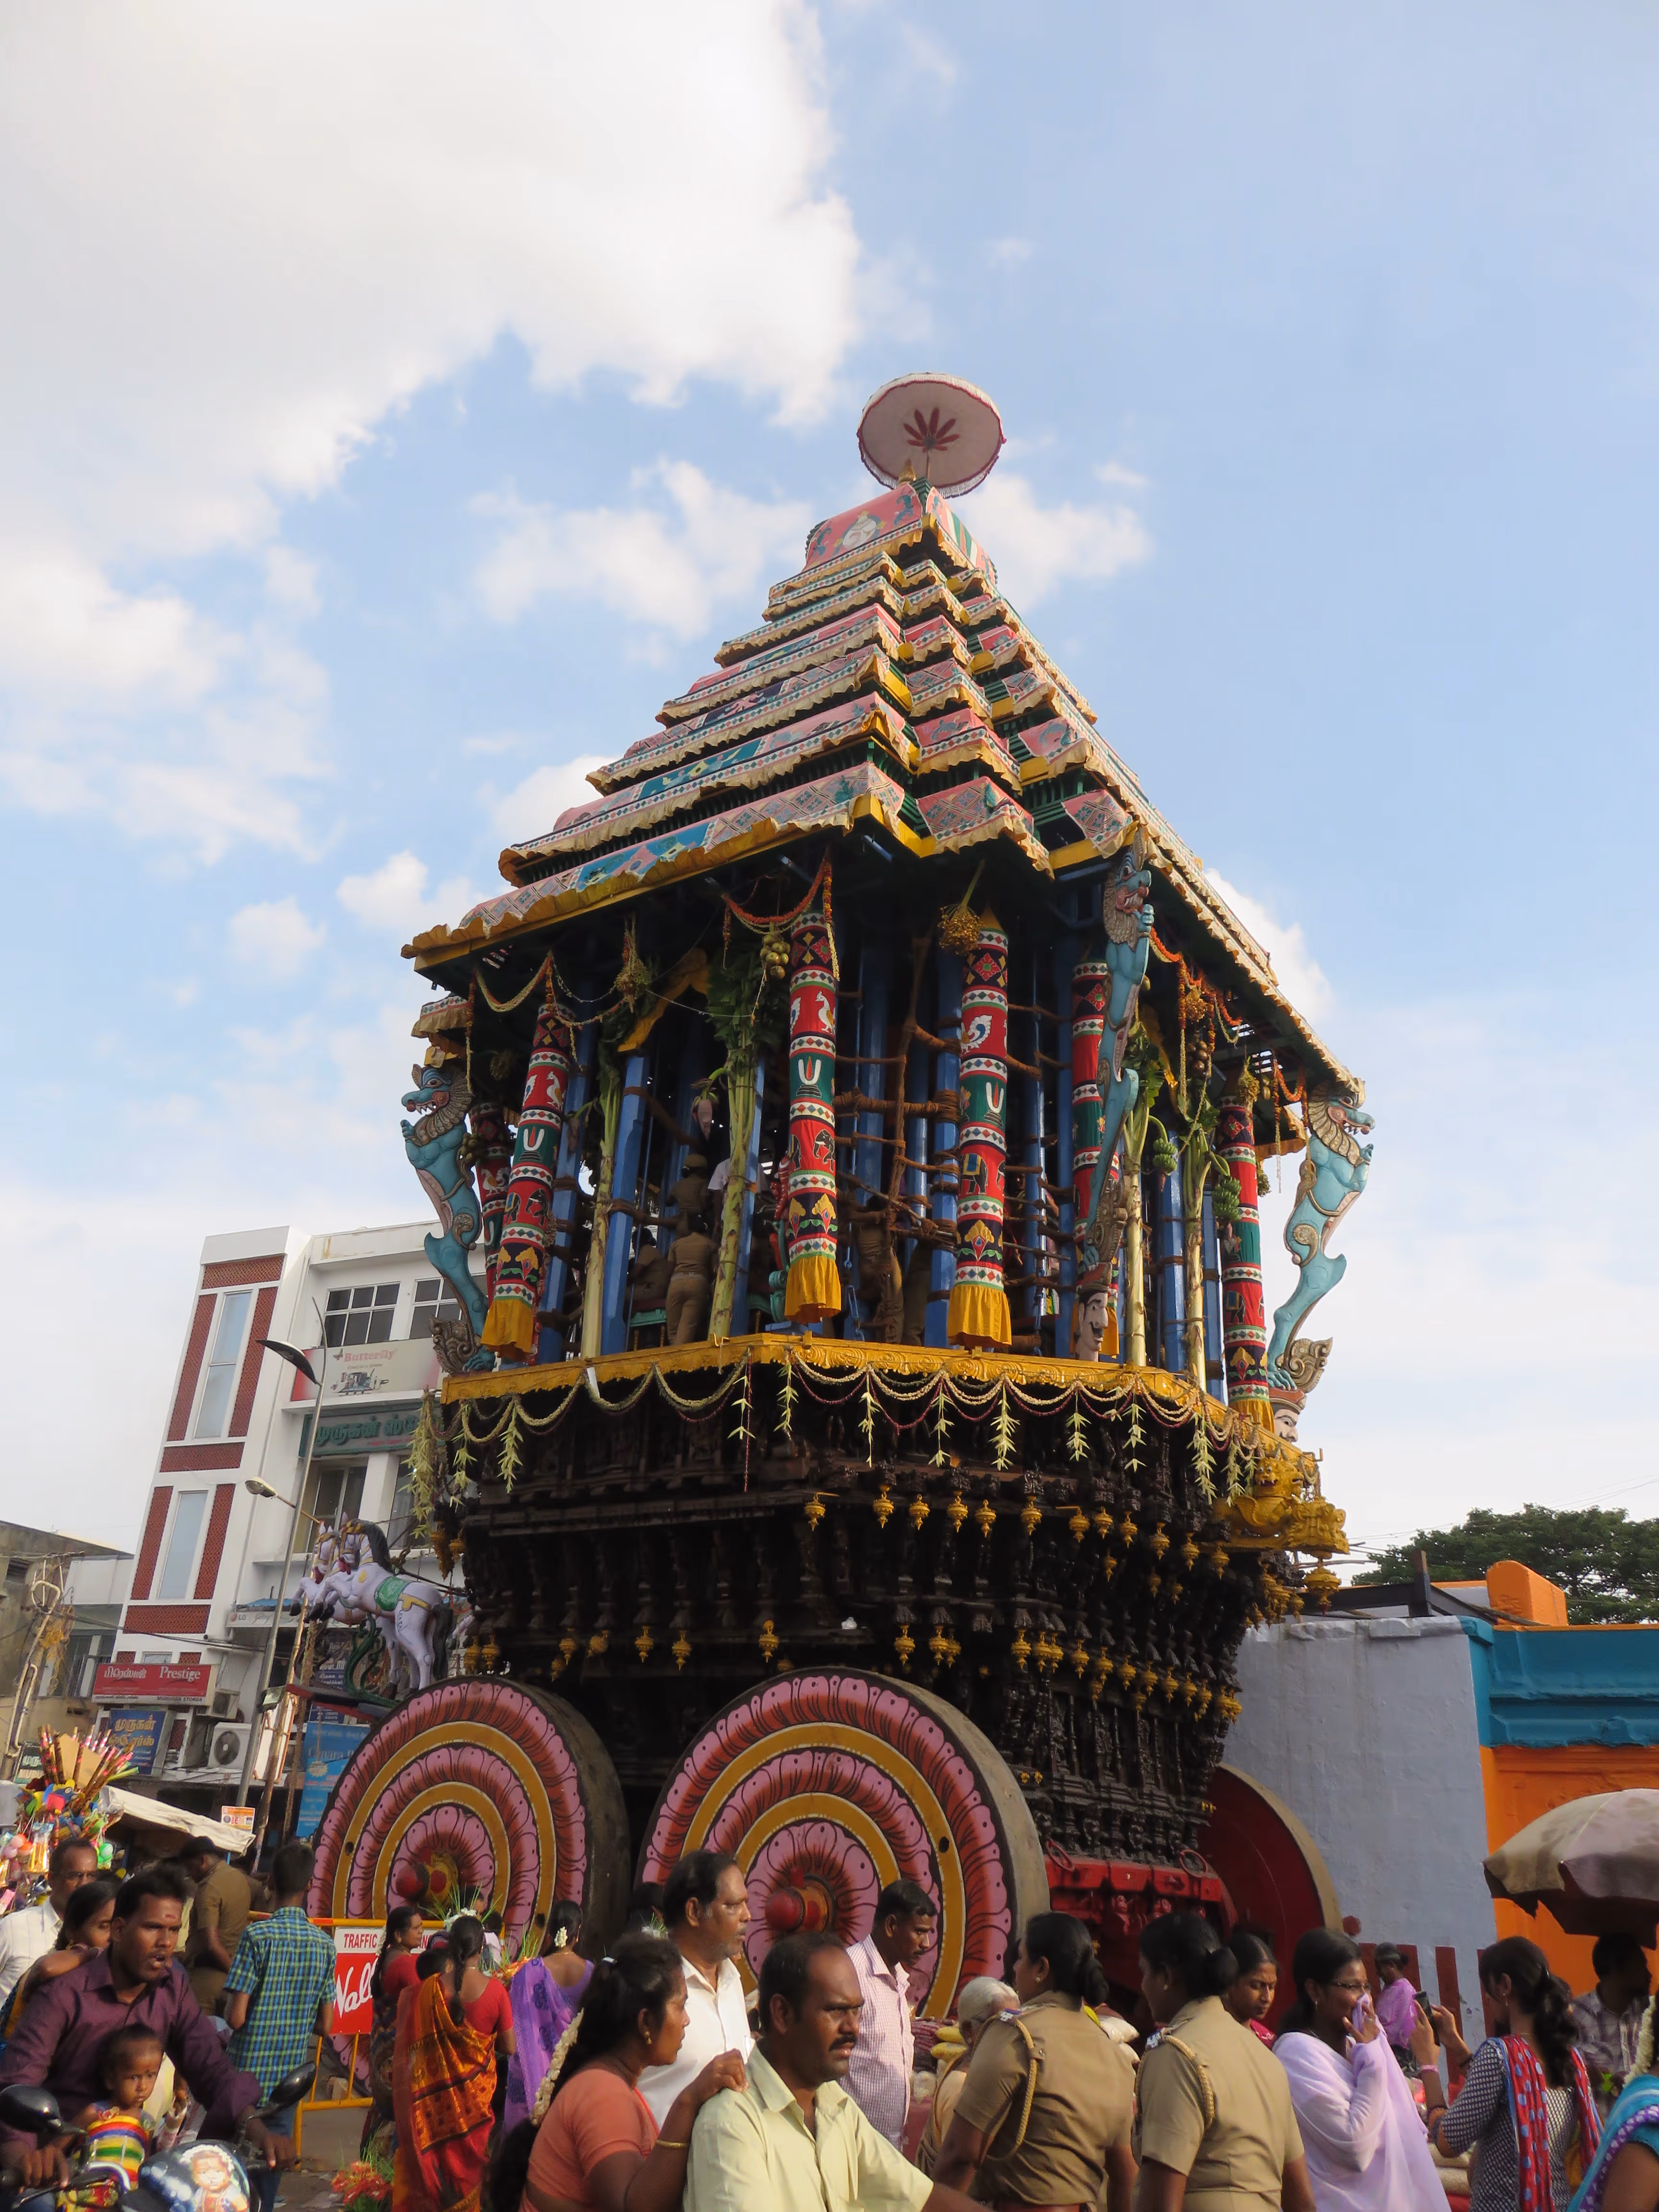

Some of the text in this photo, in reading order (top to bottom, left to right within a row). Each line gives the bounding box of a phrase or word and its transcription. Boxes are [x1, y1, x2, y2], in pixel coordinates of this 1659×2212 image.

[344, 1349, 395, 1362] Butterfly
[159, 1666, 201, 1682] Prestige
[115, 1714, 156, 1732] முருகன்
[344, 1934, 377, 1948] TRAFFIC
